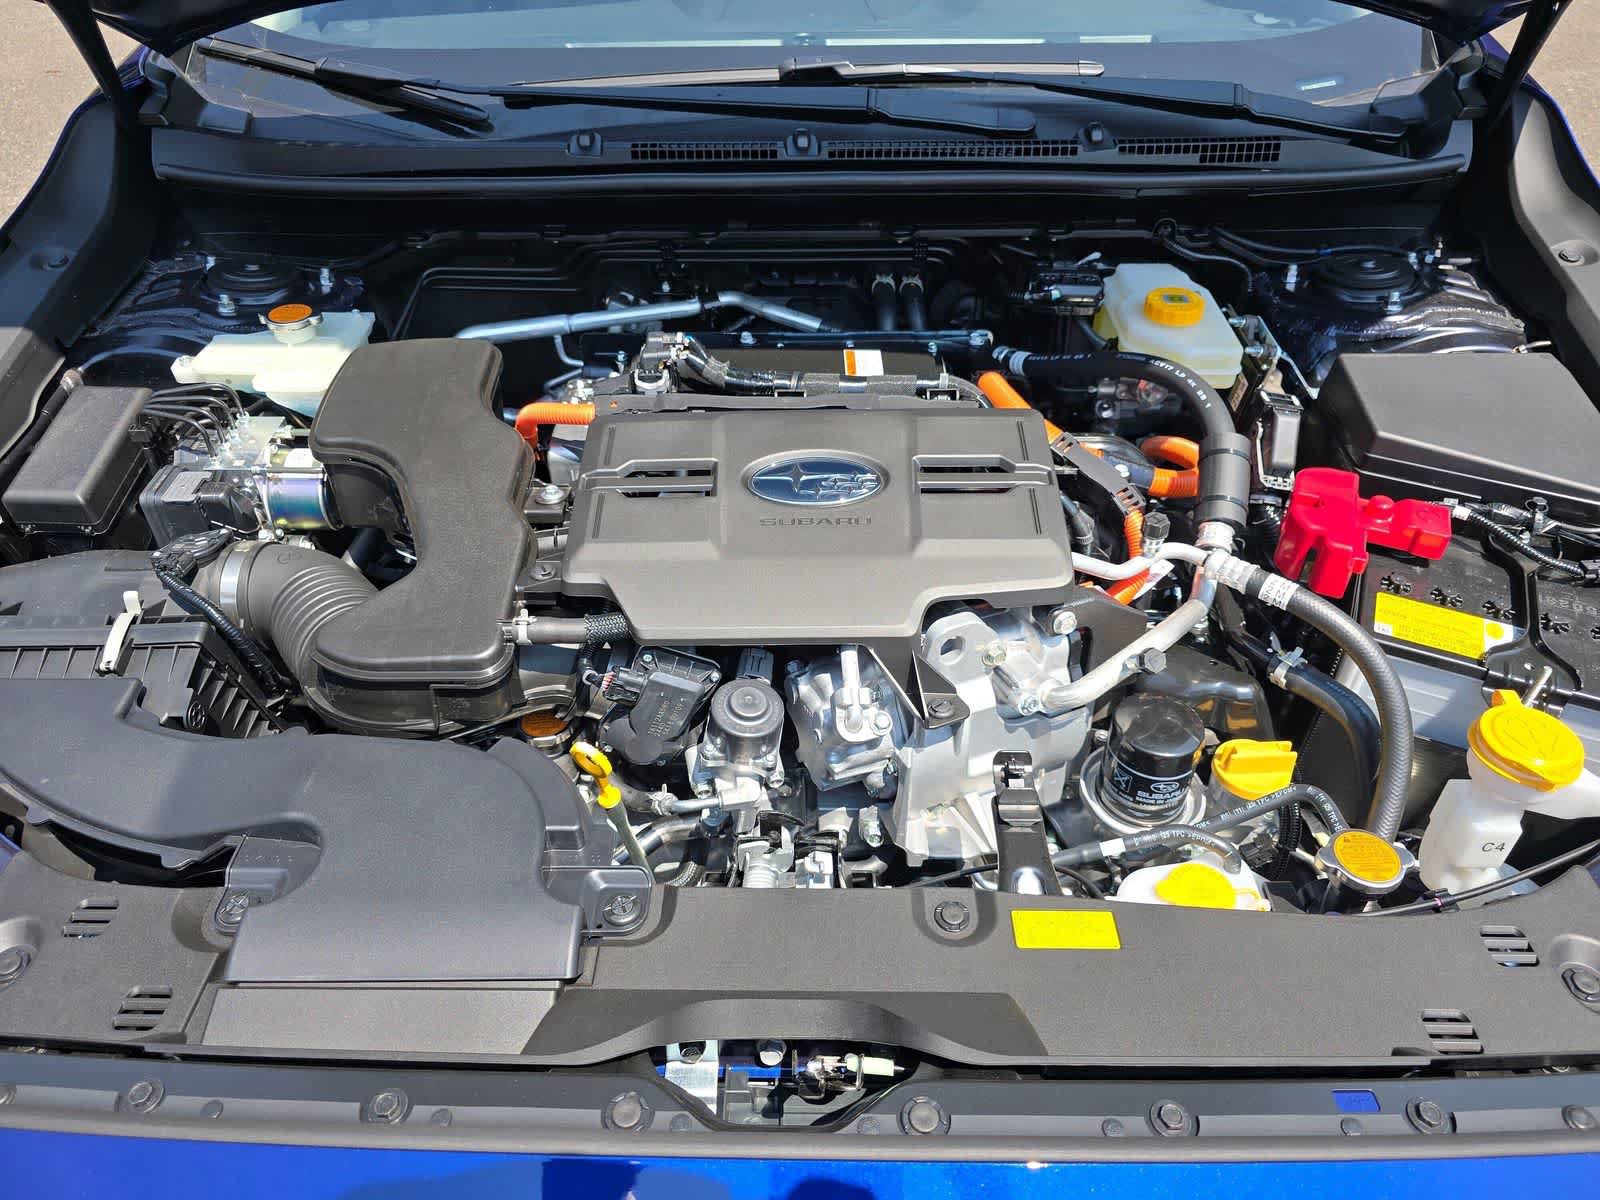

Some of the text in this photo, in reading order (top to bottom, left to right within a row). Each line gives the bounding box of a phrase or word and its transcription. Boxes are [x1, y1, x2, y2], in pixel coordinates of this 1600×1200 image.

[760, 517, 872, 526] SUBARU
[1136, 787, 1185, 800] SUBARU
[1481, 842, 1505, 852] C4
